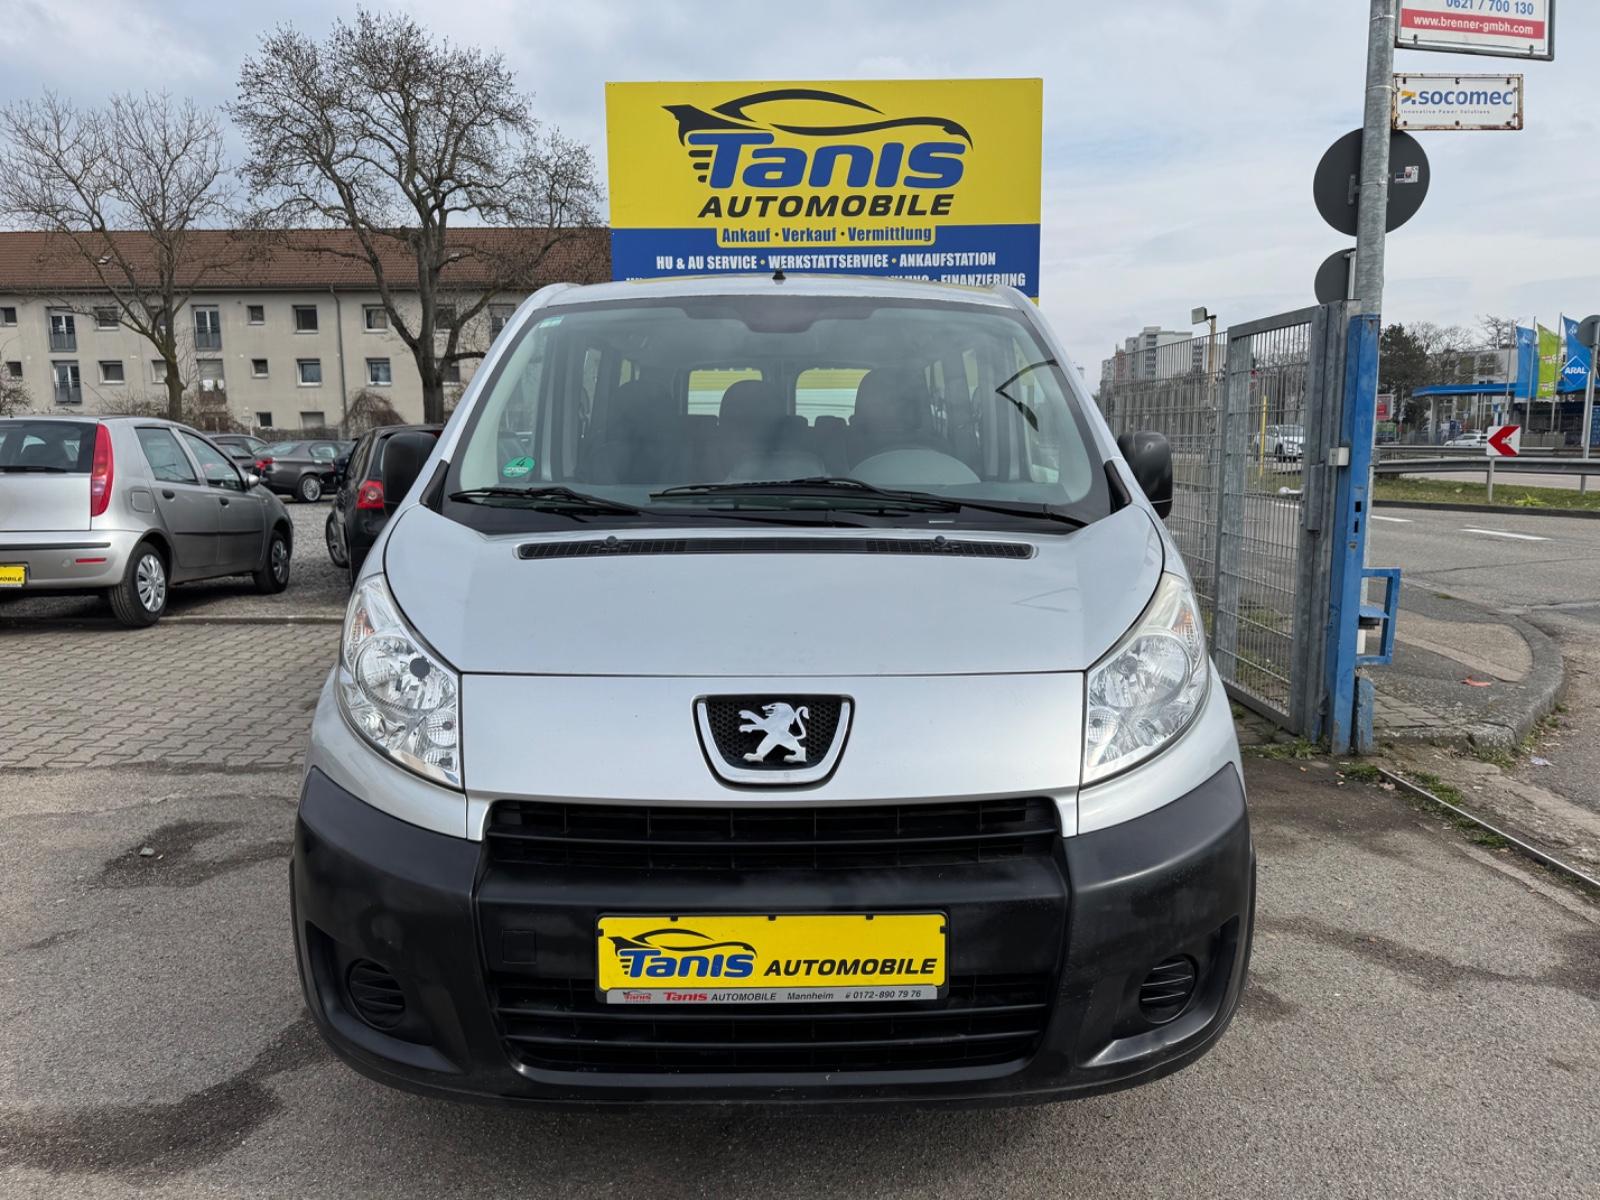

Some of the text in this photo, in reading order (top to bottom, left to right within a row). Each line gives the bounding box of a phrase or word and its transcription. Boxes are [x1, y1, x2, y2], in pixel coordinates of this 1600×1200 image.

[1446, 0, 1474, 9] 0621
[1489, 0, 1510, 13] 700
[1514, 2, 1534, 15] 130
[1413, 15, 1534, 35] www.brenner-gmbh.com
[1418, 90, 1514, 105] socomec
[697, 193, 954, 218] AUTOMOBILE
[722, 226, 932, 243] Ankauf Verkauf Vermittlung
[656, 252, 996, 270] HU & AU SERVICE WERKSTATTSERVICE ANKAUFSTATION
[764, 958, 938, 976] AUTOMOBILE
[711, 992, 776, 1001] AUTOMOBILE
[787, 992, 834, 1000] Mannheim
[853, 990, 895, 999] 0172-890
[898, 990, 908, 998] 79
[911, 989, 921, 998] 76
